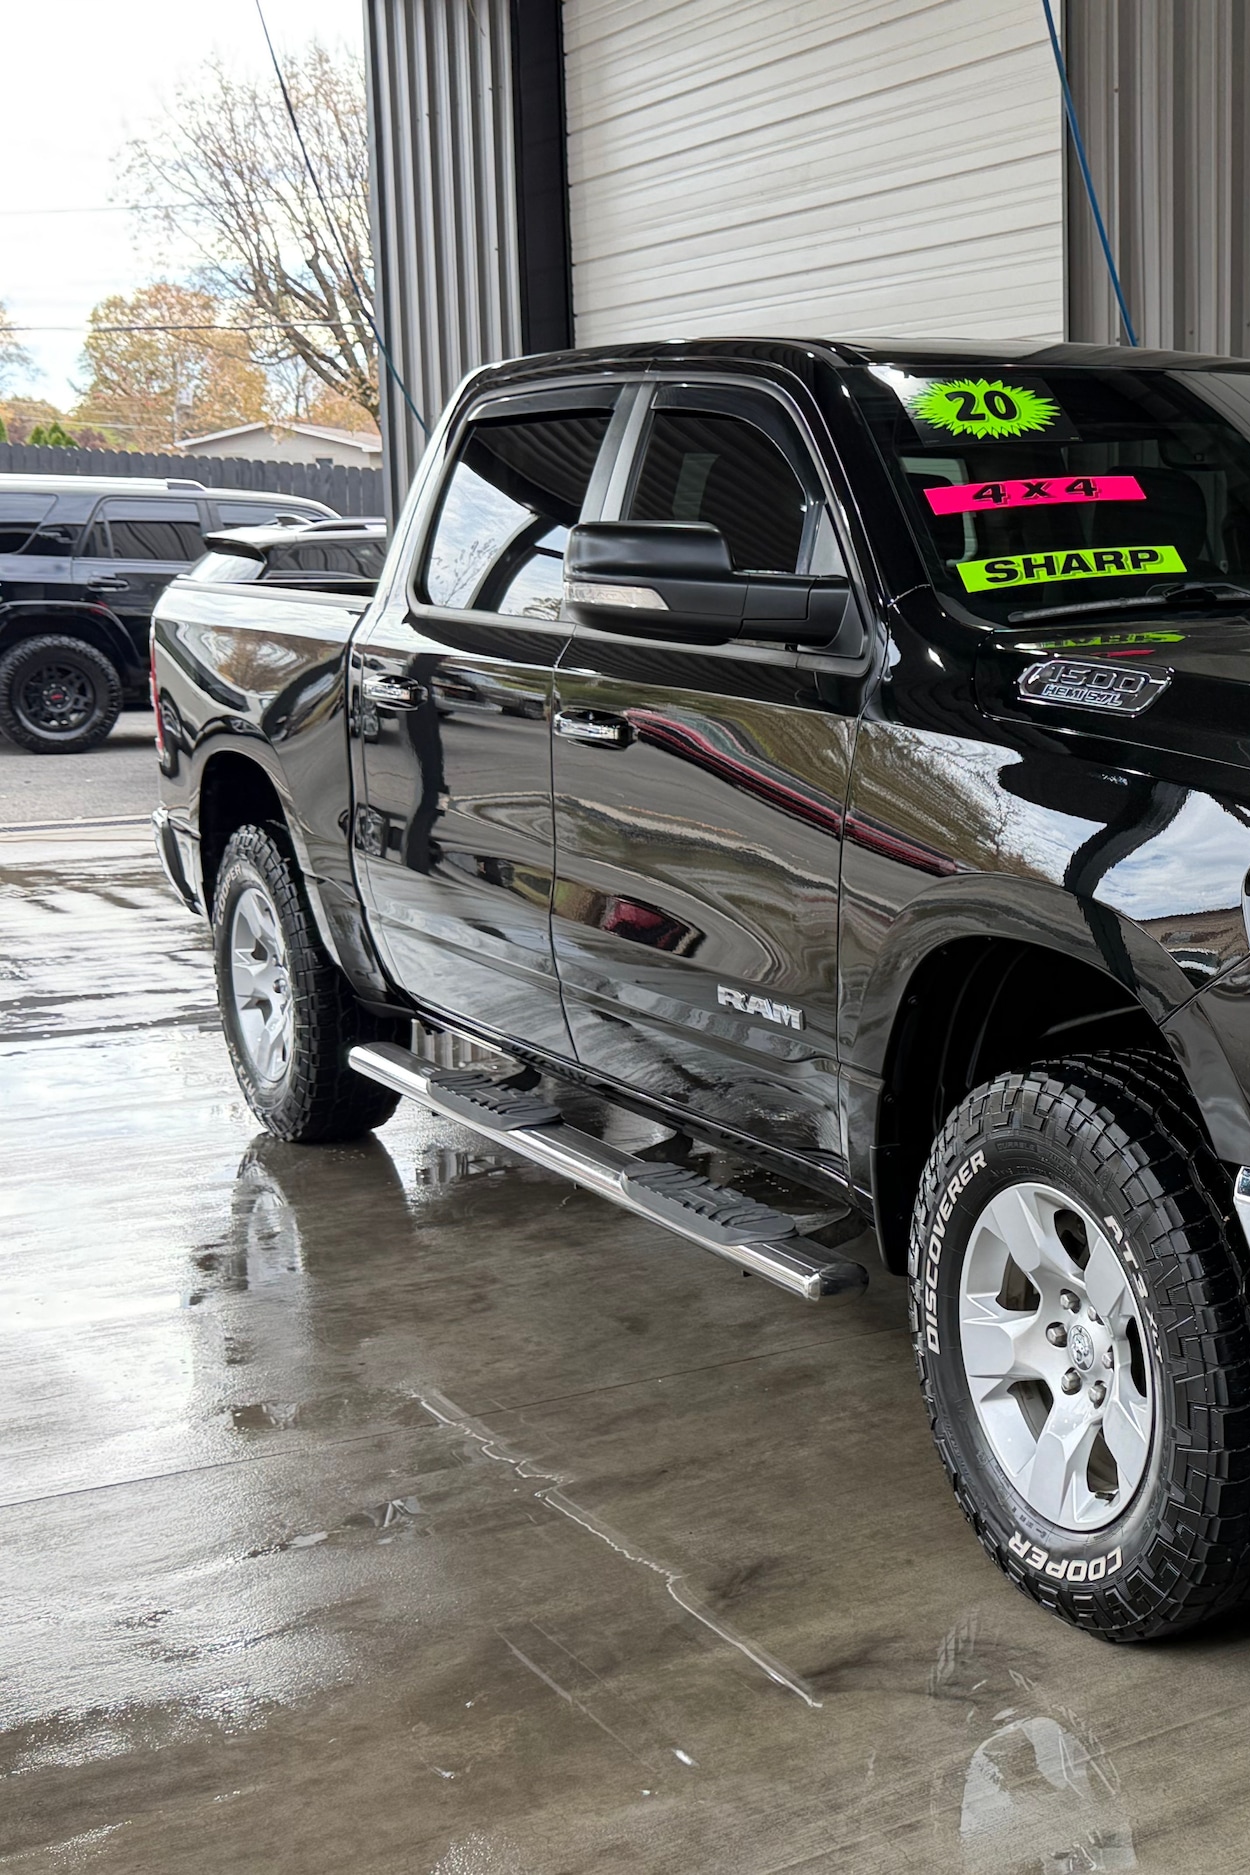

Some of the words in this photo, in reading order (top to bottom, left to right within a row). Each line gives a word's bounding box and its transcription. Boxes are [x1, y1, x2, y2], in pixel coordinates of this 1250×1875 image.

[945, 390, 1020, 421] 20
[985, 550, 1161, 584] SHARP
[1041, 665, 1146, 694] 1500
[1041, 684, 1088, 701] HEMI
[217, 863, 241, 926] COOPER
[717, 983, 805, 1031] RAM
[925, 1149, 988, 1355] DISCOVERER
[1008, 1530, 1122, 1582] COOPER
